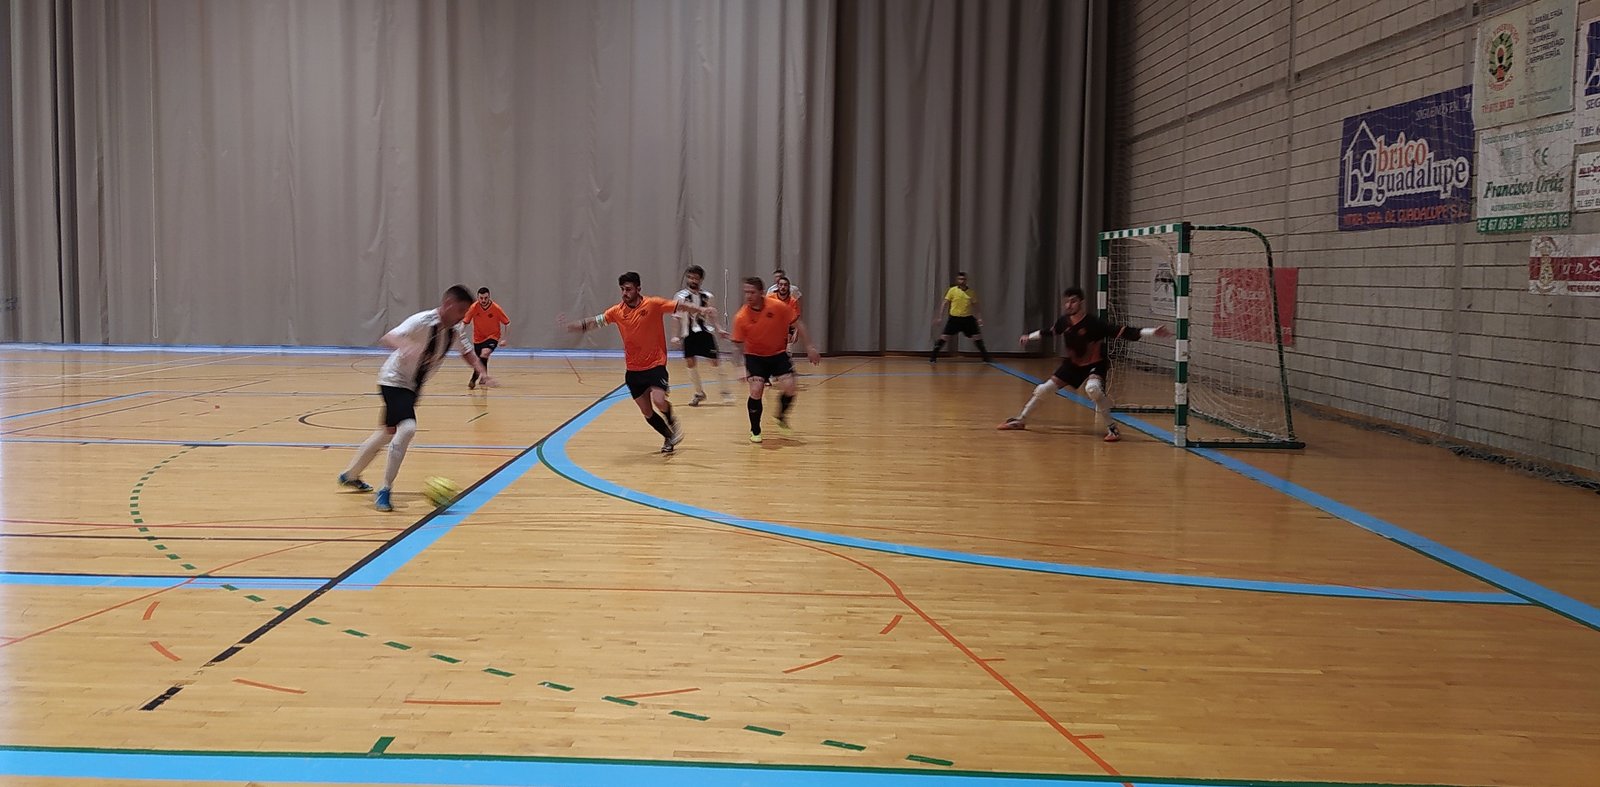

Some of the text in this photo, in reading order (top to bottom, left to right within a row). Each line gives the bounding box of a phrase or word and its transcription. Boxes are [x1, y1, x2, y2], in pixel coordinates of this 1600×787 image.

[1377, 136, 1426, 171] brico
[1376, 156, 1467, 203] guadalupe
[1483, 178, 1534, 198] Francisco
